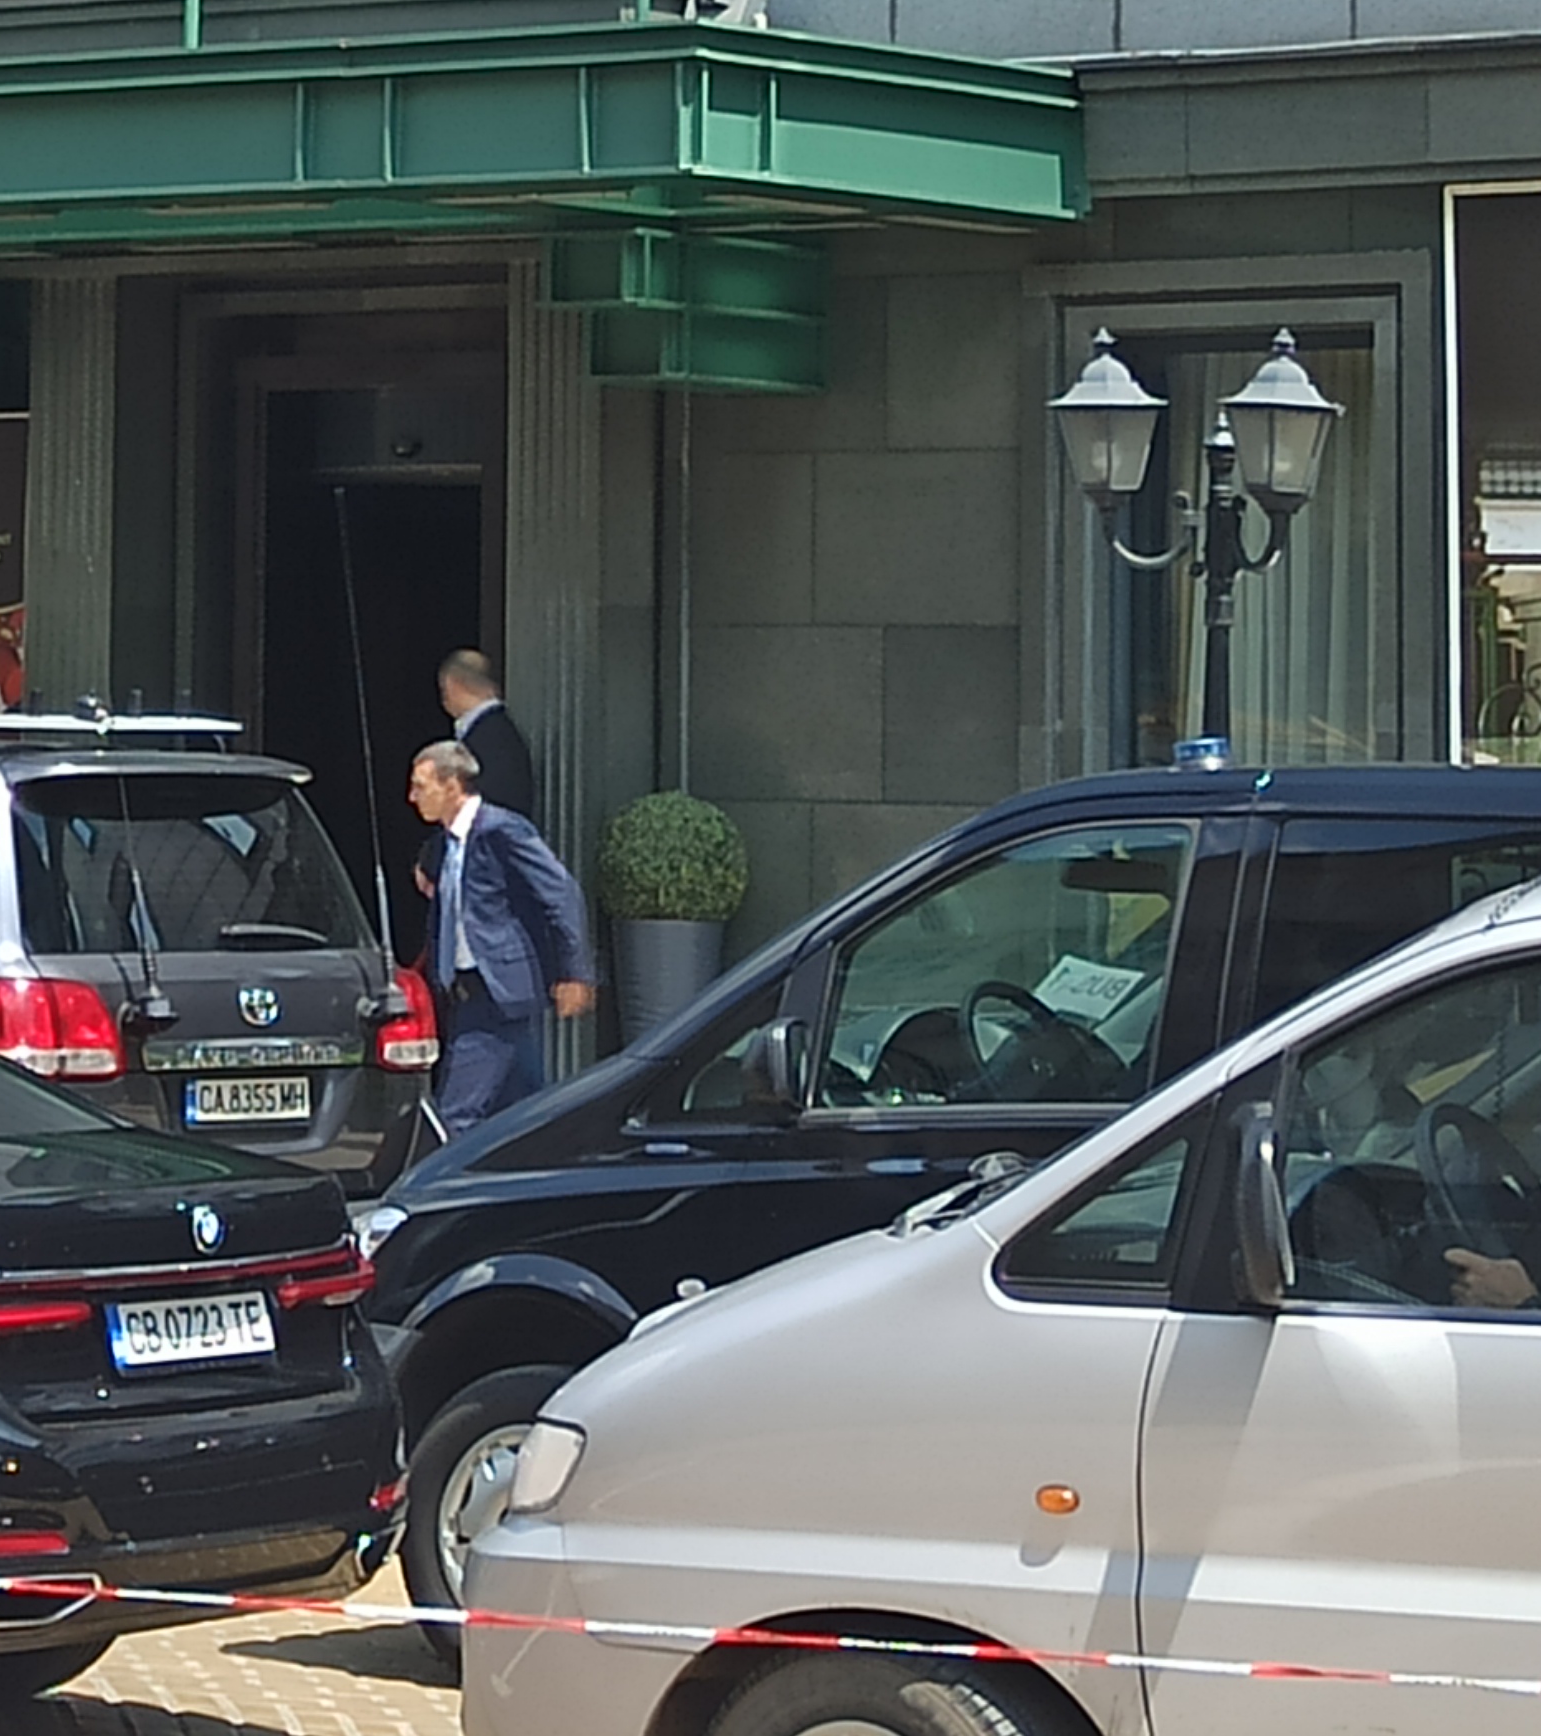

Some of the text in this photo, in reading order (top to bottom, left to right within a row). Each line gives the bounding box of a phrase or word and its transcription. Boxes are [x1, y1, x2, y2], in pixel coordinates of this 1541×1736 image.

[200, 1085, 224, 1113] CA
[229, 1083, 275, 1112] 8355
[127, 1311, 162, 1354] CB
[166, 1306, 227, 1349] 0723
